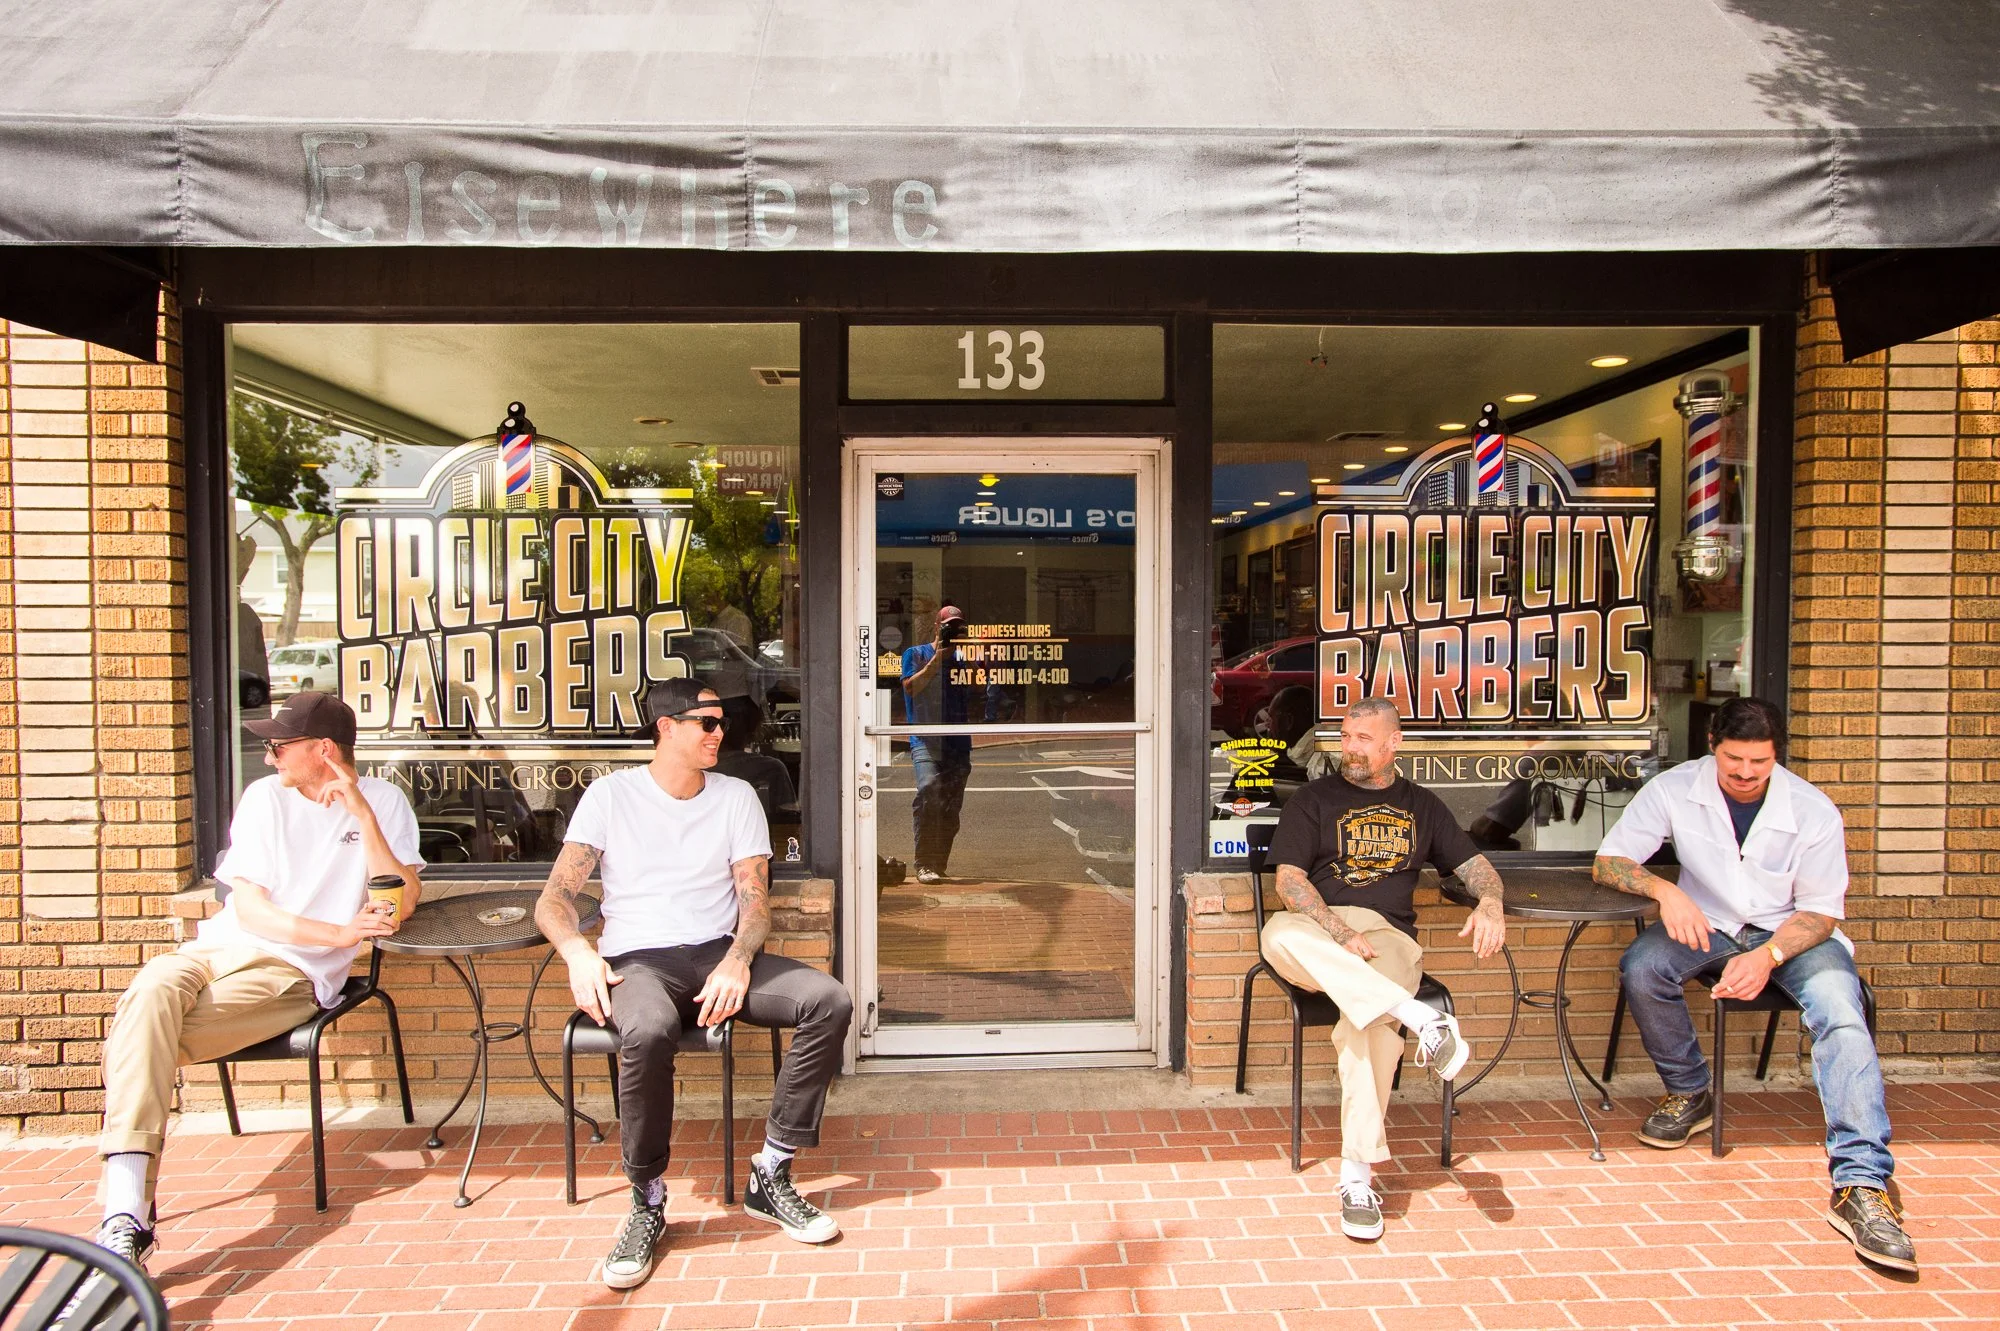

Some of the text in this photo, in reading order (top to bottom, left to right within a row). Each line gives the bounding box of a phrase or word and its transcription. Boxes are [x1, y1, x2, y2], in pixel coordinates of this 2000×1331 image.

[958, 329, 1046, 391] 133
[338, 515, 692, 641] CIRCLE CITY
[1319, 512, 1651, 634] CIRCLE CITY
[967, 624, 1051, 638] BUSINESS HOURS
[860, 629, 869, 667] PUSH
[956, 644, 1063, 662] MON-FRI 10-6:30
[340, 609, 692, 731] BARBERS
[950, 667, 1069, 685] SAT & SUN 10-4:00
[1318, 604, 1650, 722] BARBERS
[1221, 738, 1287, 751] SHINER GOLD
[1236, 749, 1271, 757] POMADE
[443, 765, 500, 790] FINE
[510, 765, 640, 791] GROO
[1411, 755, 1468, 781] FINE
[1475, 755, 1642, 781] GROOMING
[1255, 779, 1274, 787] HERE
[1356, 814, 1399, 826] GENUINE
